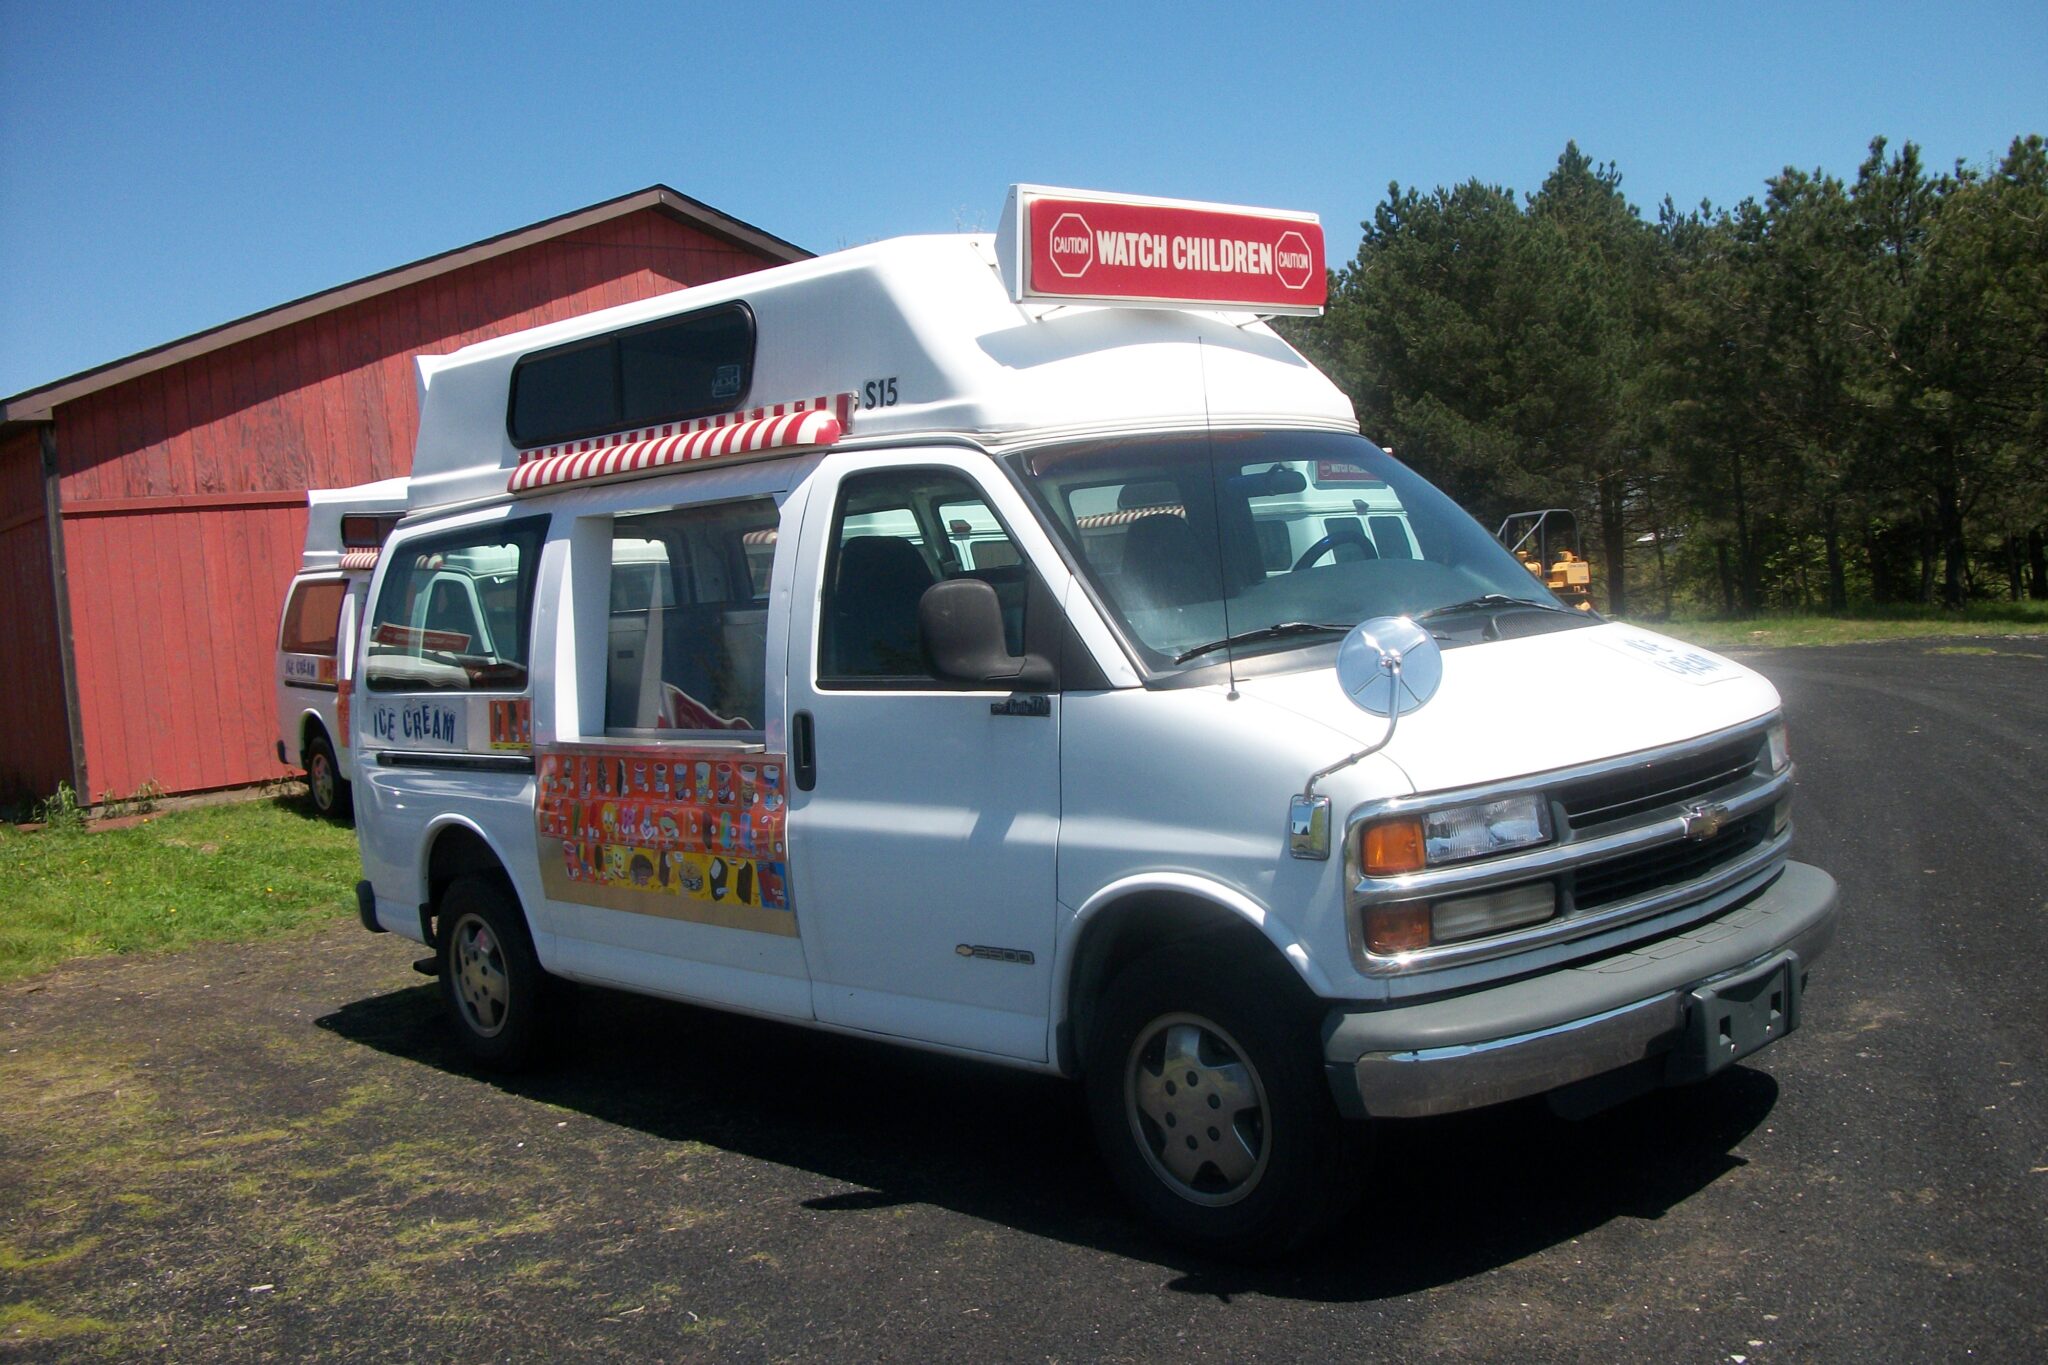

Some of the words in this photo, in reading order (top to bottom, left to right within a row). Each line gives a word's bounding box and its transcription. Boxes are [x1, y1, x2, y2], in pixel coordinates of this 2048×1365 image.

[1054, 236, 1088, 255] CAUTION
[1096, 230, 1167, 268] WATCH
[1172, 236, 1273, 275] CHILDREN
[1278, 251, 1308, 269] CAUTION
[865, 377, 898, 410] S15
[373, 706, 395, 742] ICE
[403, 703, 456, 744] CREAM
